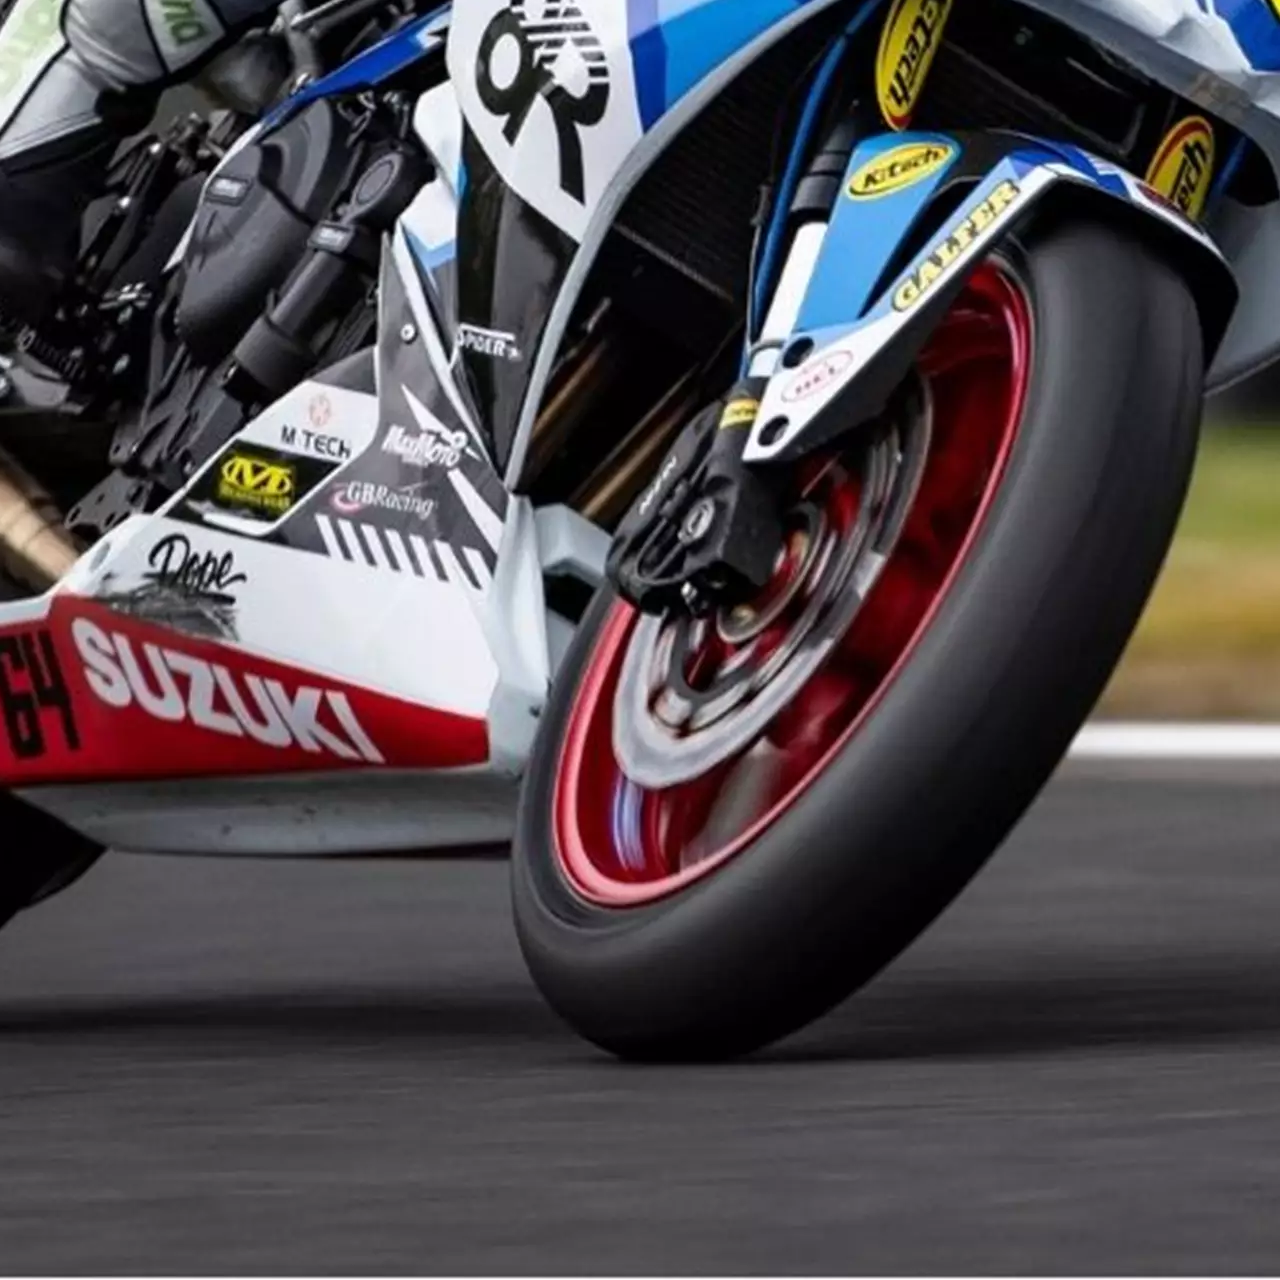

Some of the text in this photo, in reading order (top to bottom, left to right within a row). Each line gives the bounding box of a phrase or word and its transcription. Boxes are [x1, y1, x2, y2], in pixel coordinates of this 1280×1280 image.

[892, 179, 1020, 312] GALFER
[148, 532, 248, 594] Dope
[70, 617, 386, 764] SUZUKI
